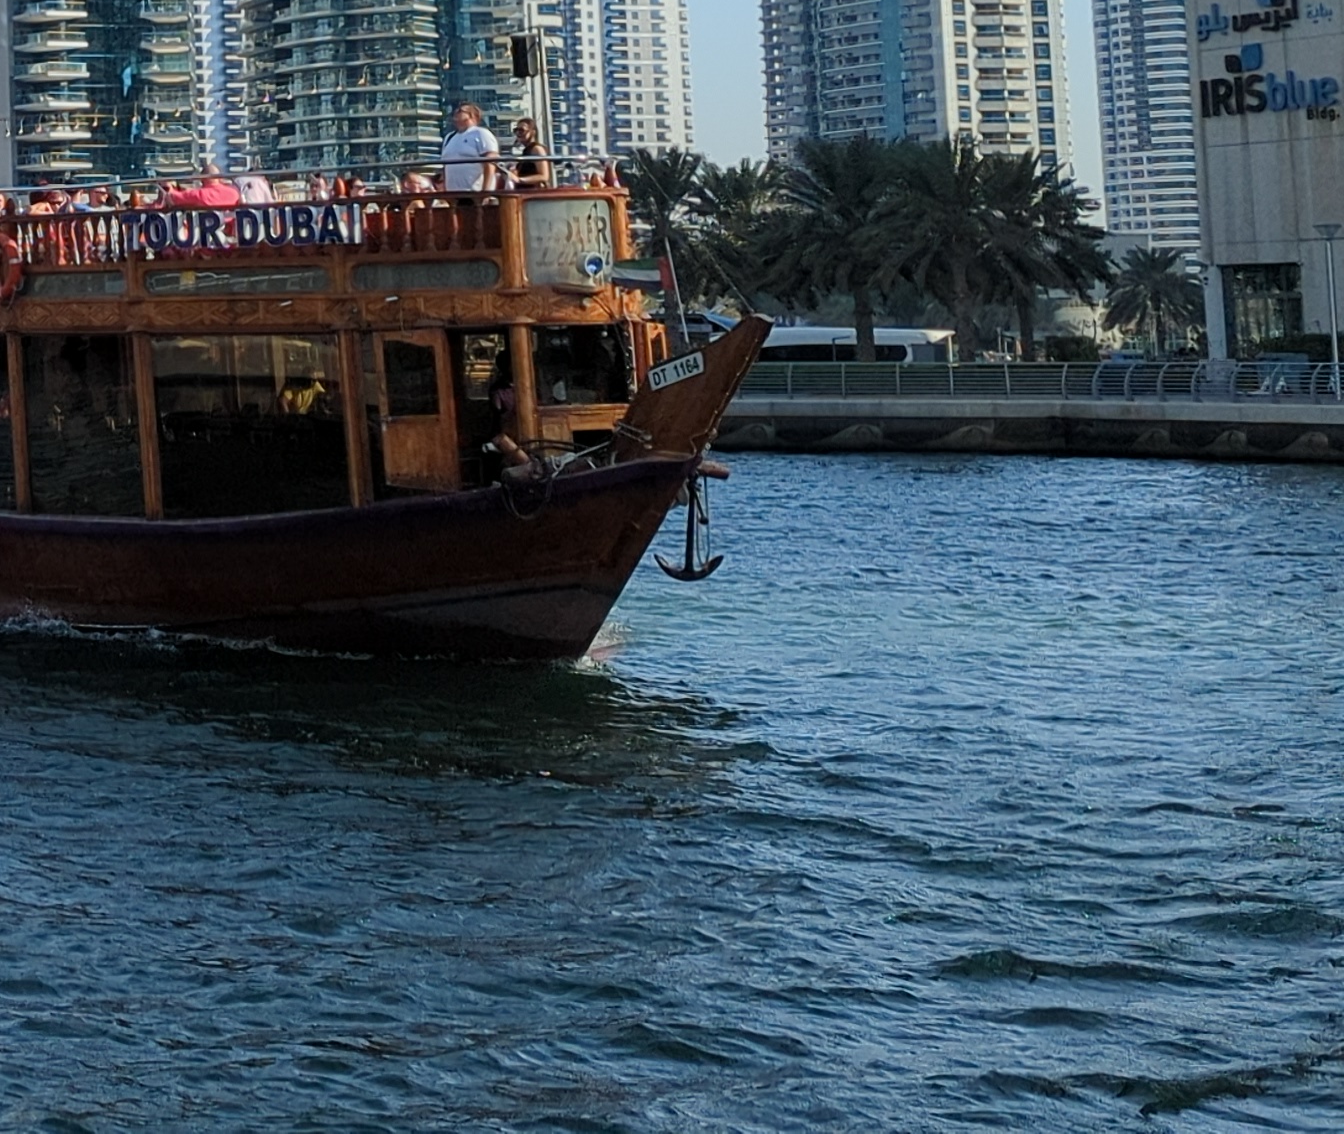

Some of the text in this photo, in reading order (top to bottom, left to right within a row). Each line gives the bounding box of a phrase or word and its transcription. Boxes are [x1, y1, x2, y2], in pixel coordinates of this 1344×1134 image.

[1306, 105, 1341, 121] Bldg.
[119, 203, 361, 251] TOUR DUBAI
[652, 356, 700, 386] DT 1164
